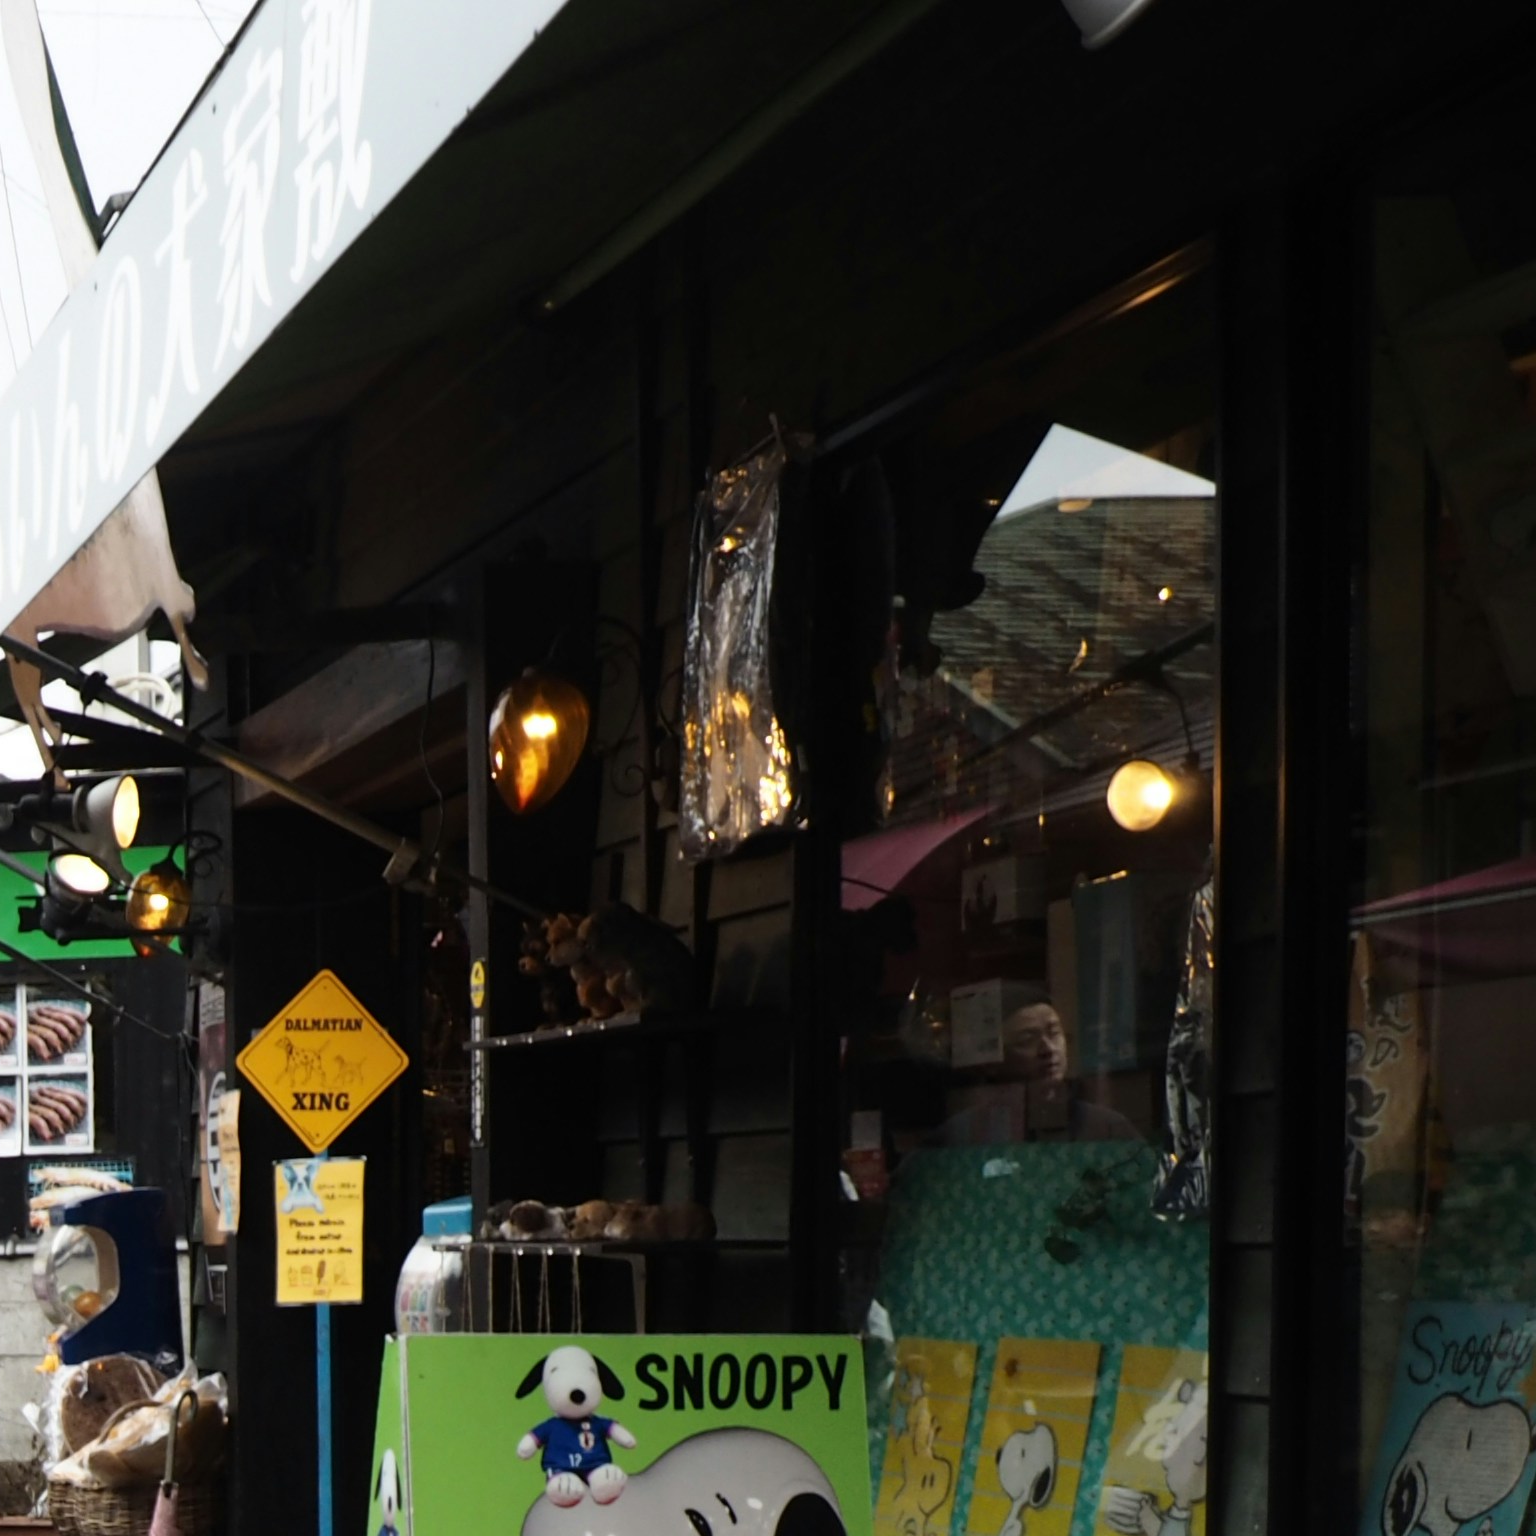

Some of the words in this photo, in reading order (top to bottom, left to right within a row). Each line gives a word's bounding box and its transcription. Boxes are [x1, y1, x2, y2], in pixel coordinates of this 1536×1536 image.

[284, 1017, 364, 1034] DALMATIAN
[290, 1091, 351, 1113] XING
[1407, 1314, 1534, 1398] Snoopy
[636, 1352, 848, 1412] SNOOPY
